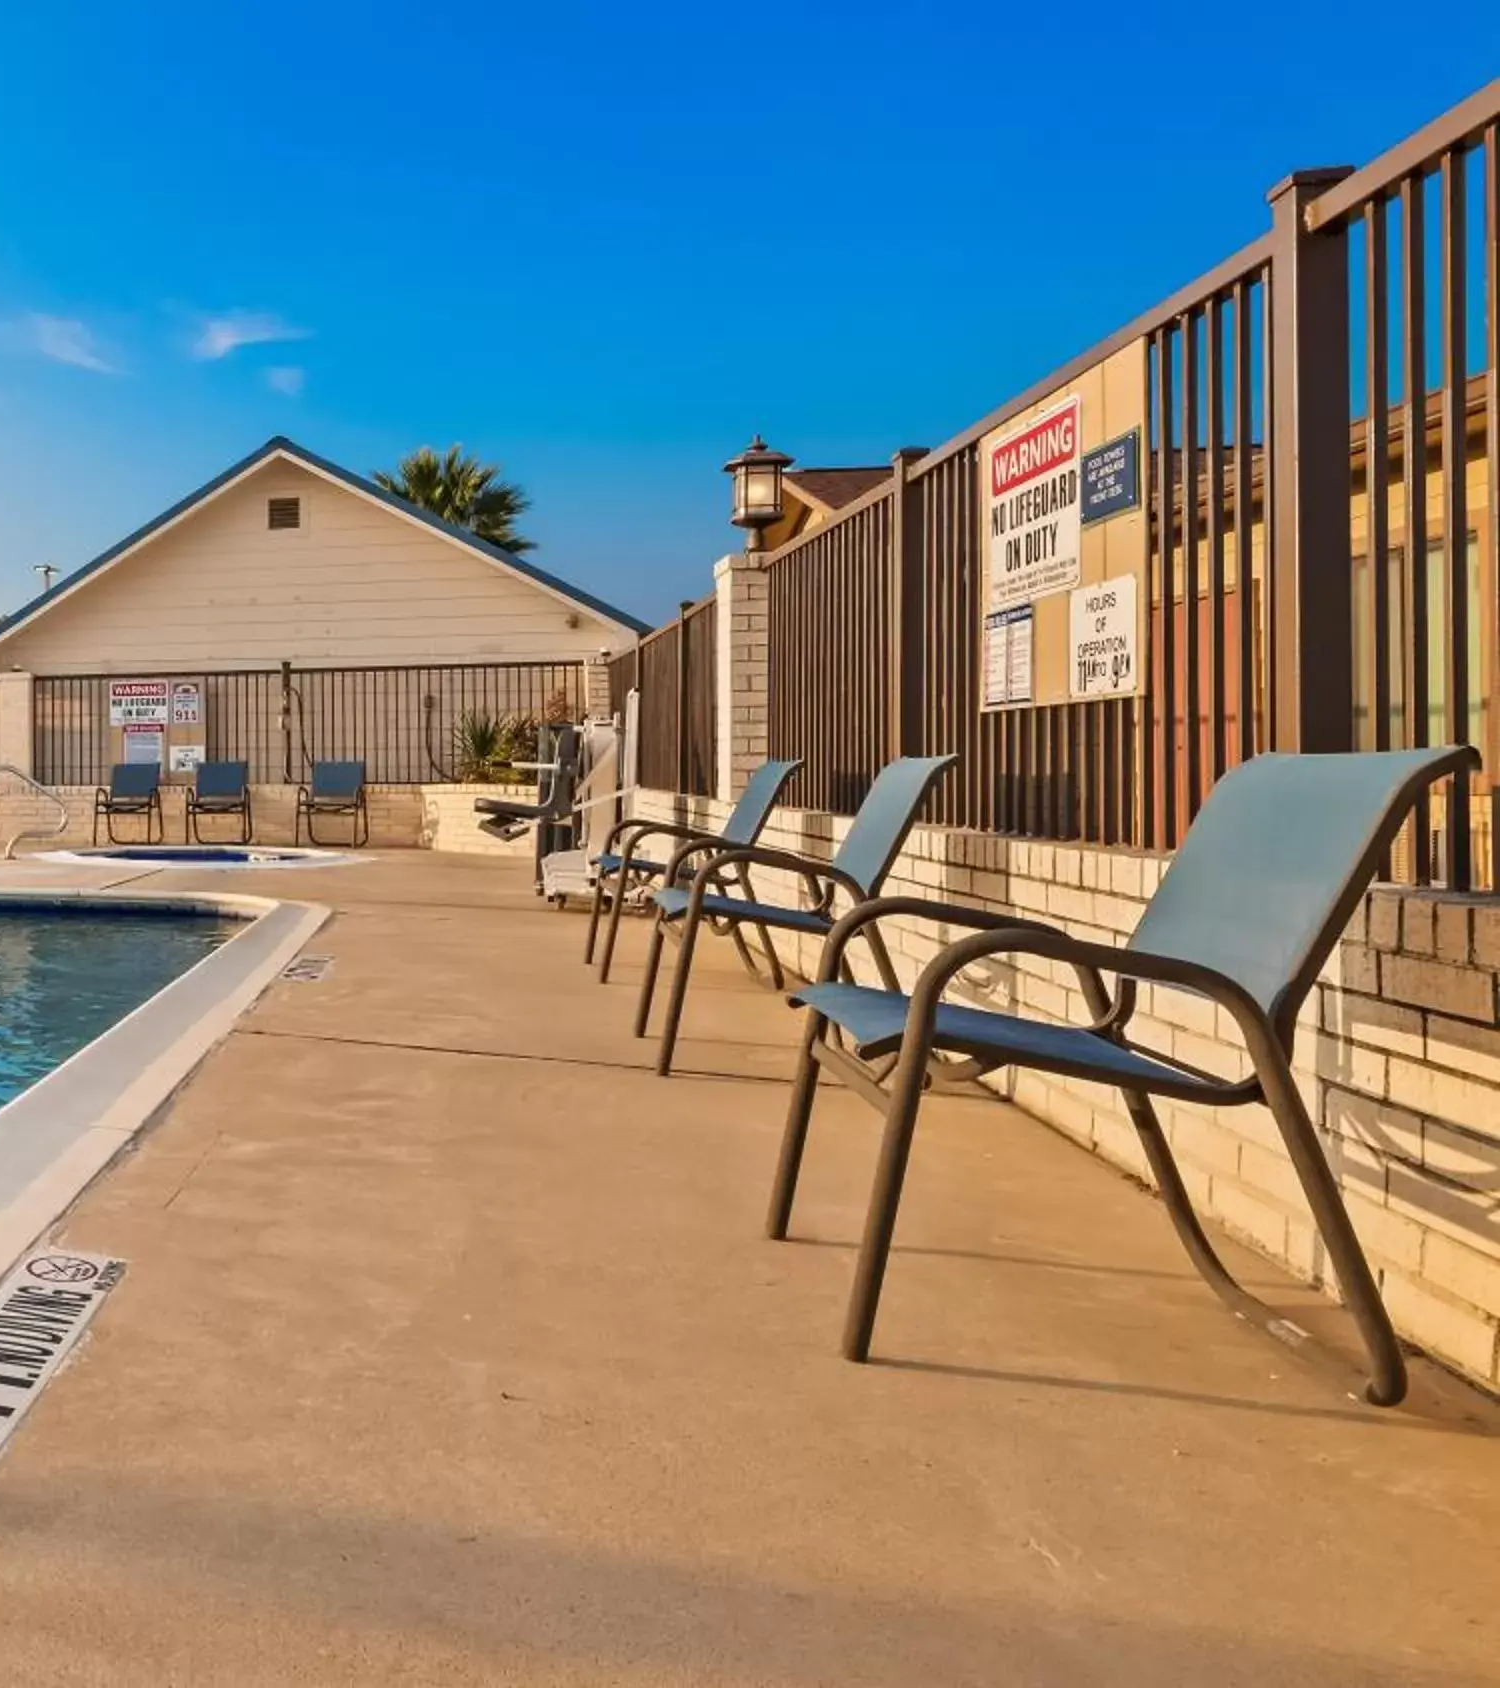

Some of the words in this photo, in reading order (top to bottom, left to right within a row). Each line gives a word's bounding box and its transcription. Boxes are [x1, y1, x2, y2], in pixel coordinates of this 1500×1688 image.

[995, 417, 1073, 487] WARNING
[992, 502, 1007, 538] NO
[1009, 469, 1077, 530] LIFEGUARD
[1005, 535, 1021, 573] ON
[1025, 521, 1059, 566] DUTY
[1085, 592, 1116, 613] HOURS
[1095, 616, 1106, 633] OF
[1077, 634, 1127, 659] OPERATION
[114, 685, 165, 695] WARNING
[175, 710, 197, 721] 911
